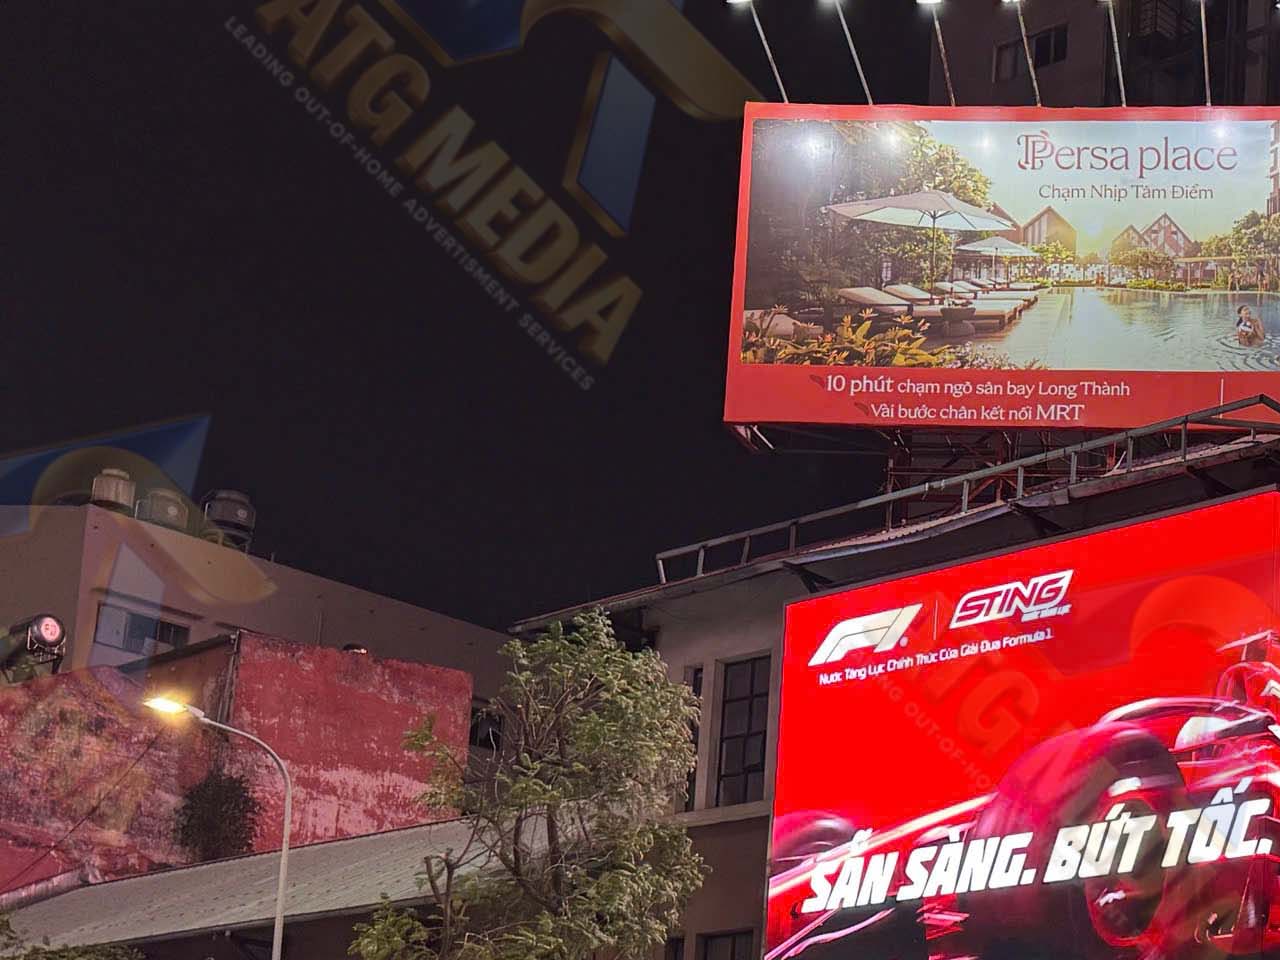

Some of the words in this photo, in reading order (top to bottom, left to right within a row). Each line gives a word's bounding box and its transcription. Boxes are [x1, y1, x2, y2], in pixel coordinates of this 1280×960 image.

[1138, 136, 1238, 178] place
[1038, 185, 1087, 201] Chạm
[1090, 184, 1128, 201] Nhịp
[1131, 184, 1167, 199] Tâm
[1171, 183, 1214, 199] Điểm
[826, 375, 846, 392] 10
[850, 374, 895, 396] phút
[897, 380, 939, 398] chạm
[944, 380, 973, 398] ngõ
[975, 380, 1003, 395] sân
[1006, 380, 1035, 398] bay
[1038, 380, 1077, 398] Long
[1080, 380, 1130, 396] Thành
[870, 402, 895, 418] Vài
[898, 402, 937, 419] bước
[939, 404, 975, 420] chân
[980, 402, 1005, 420] kết
[1008, 403, 1033, 420] nối
[1036, 404, 1085, 421] MRT
[949, 569, 1075, 629] STING
[1002, 633, 1047, 649] Formula
